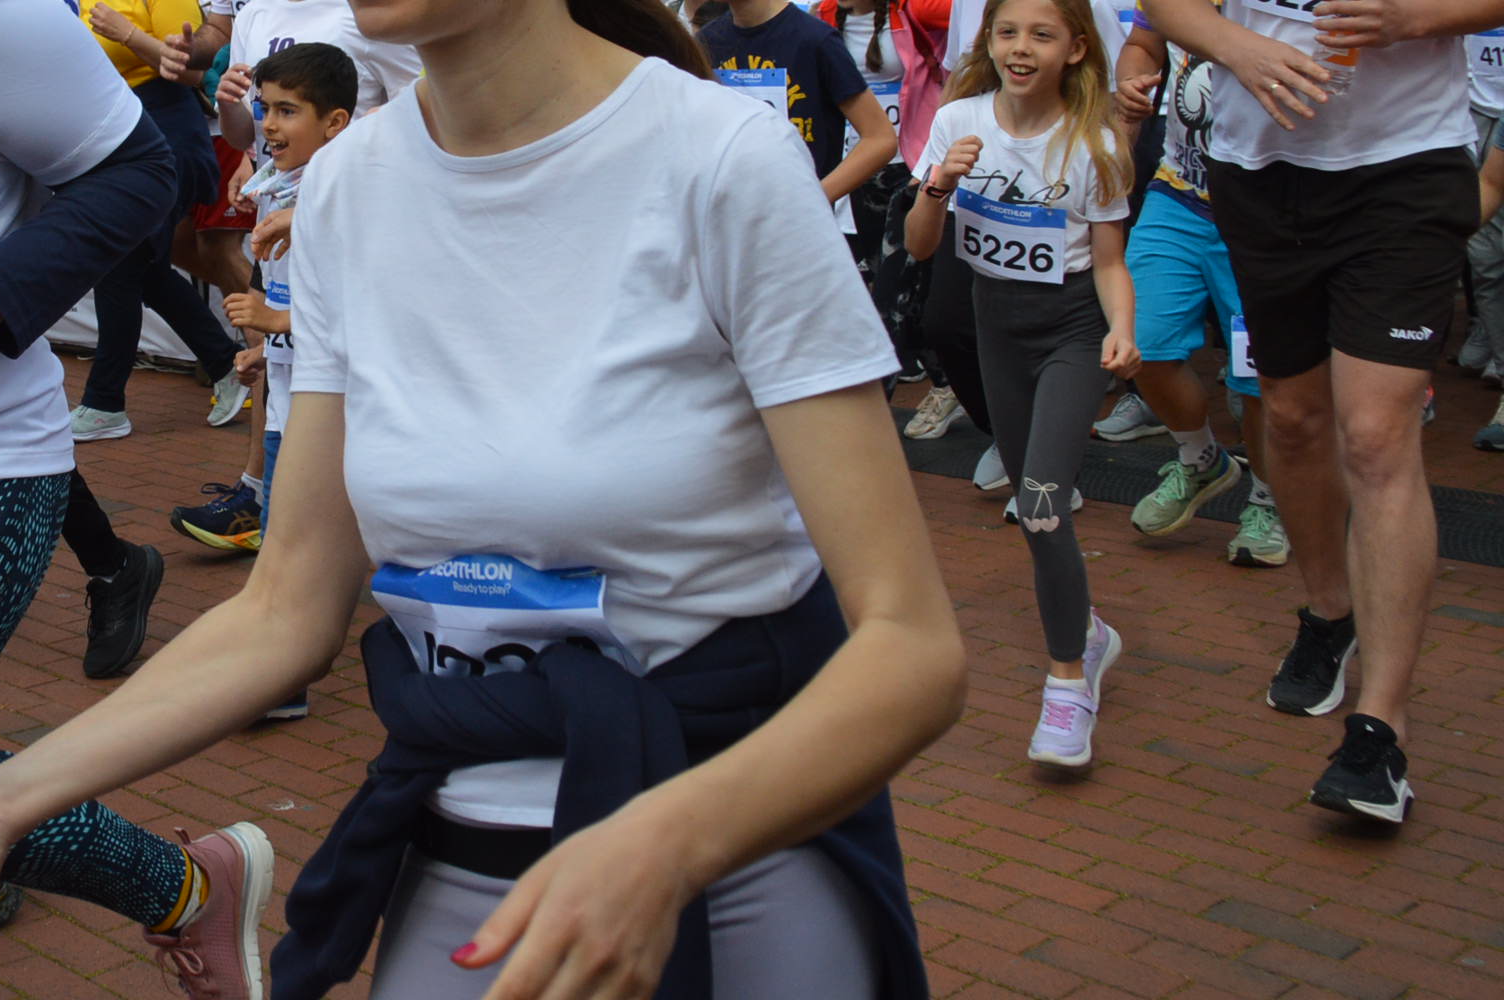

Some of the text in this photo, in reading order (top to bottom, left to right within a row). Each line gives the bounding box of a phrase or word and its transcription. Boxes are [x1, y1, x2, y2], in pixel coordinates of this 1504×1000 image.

[1480, 46, 1504, 67] 41
[963, 225, 1055, 273] 5226
[1389, 327, 1427, 341] JAKO
[452, 581, 512, 595] Ready to play?
